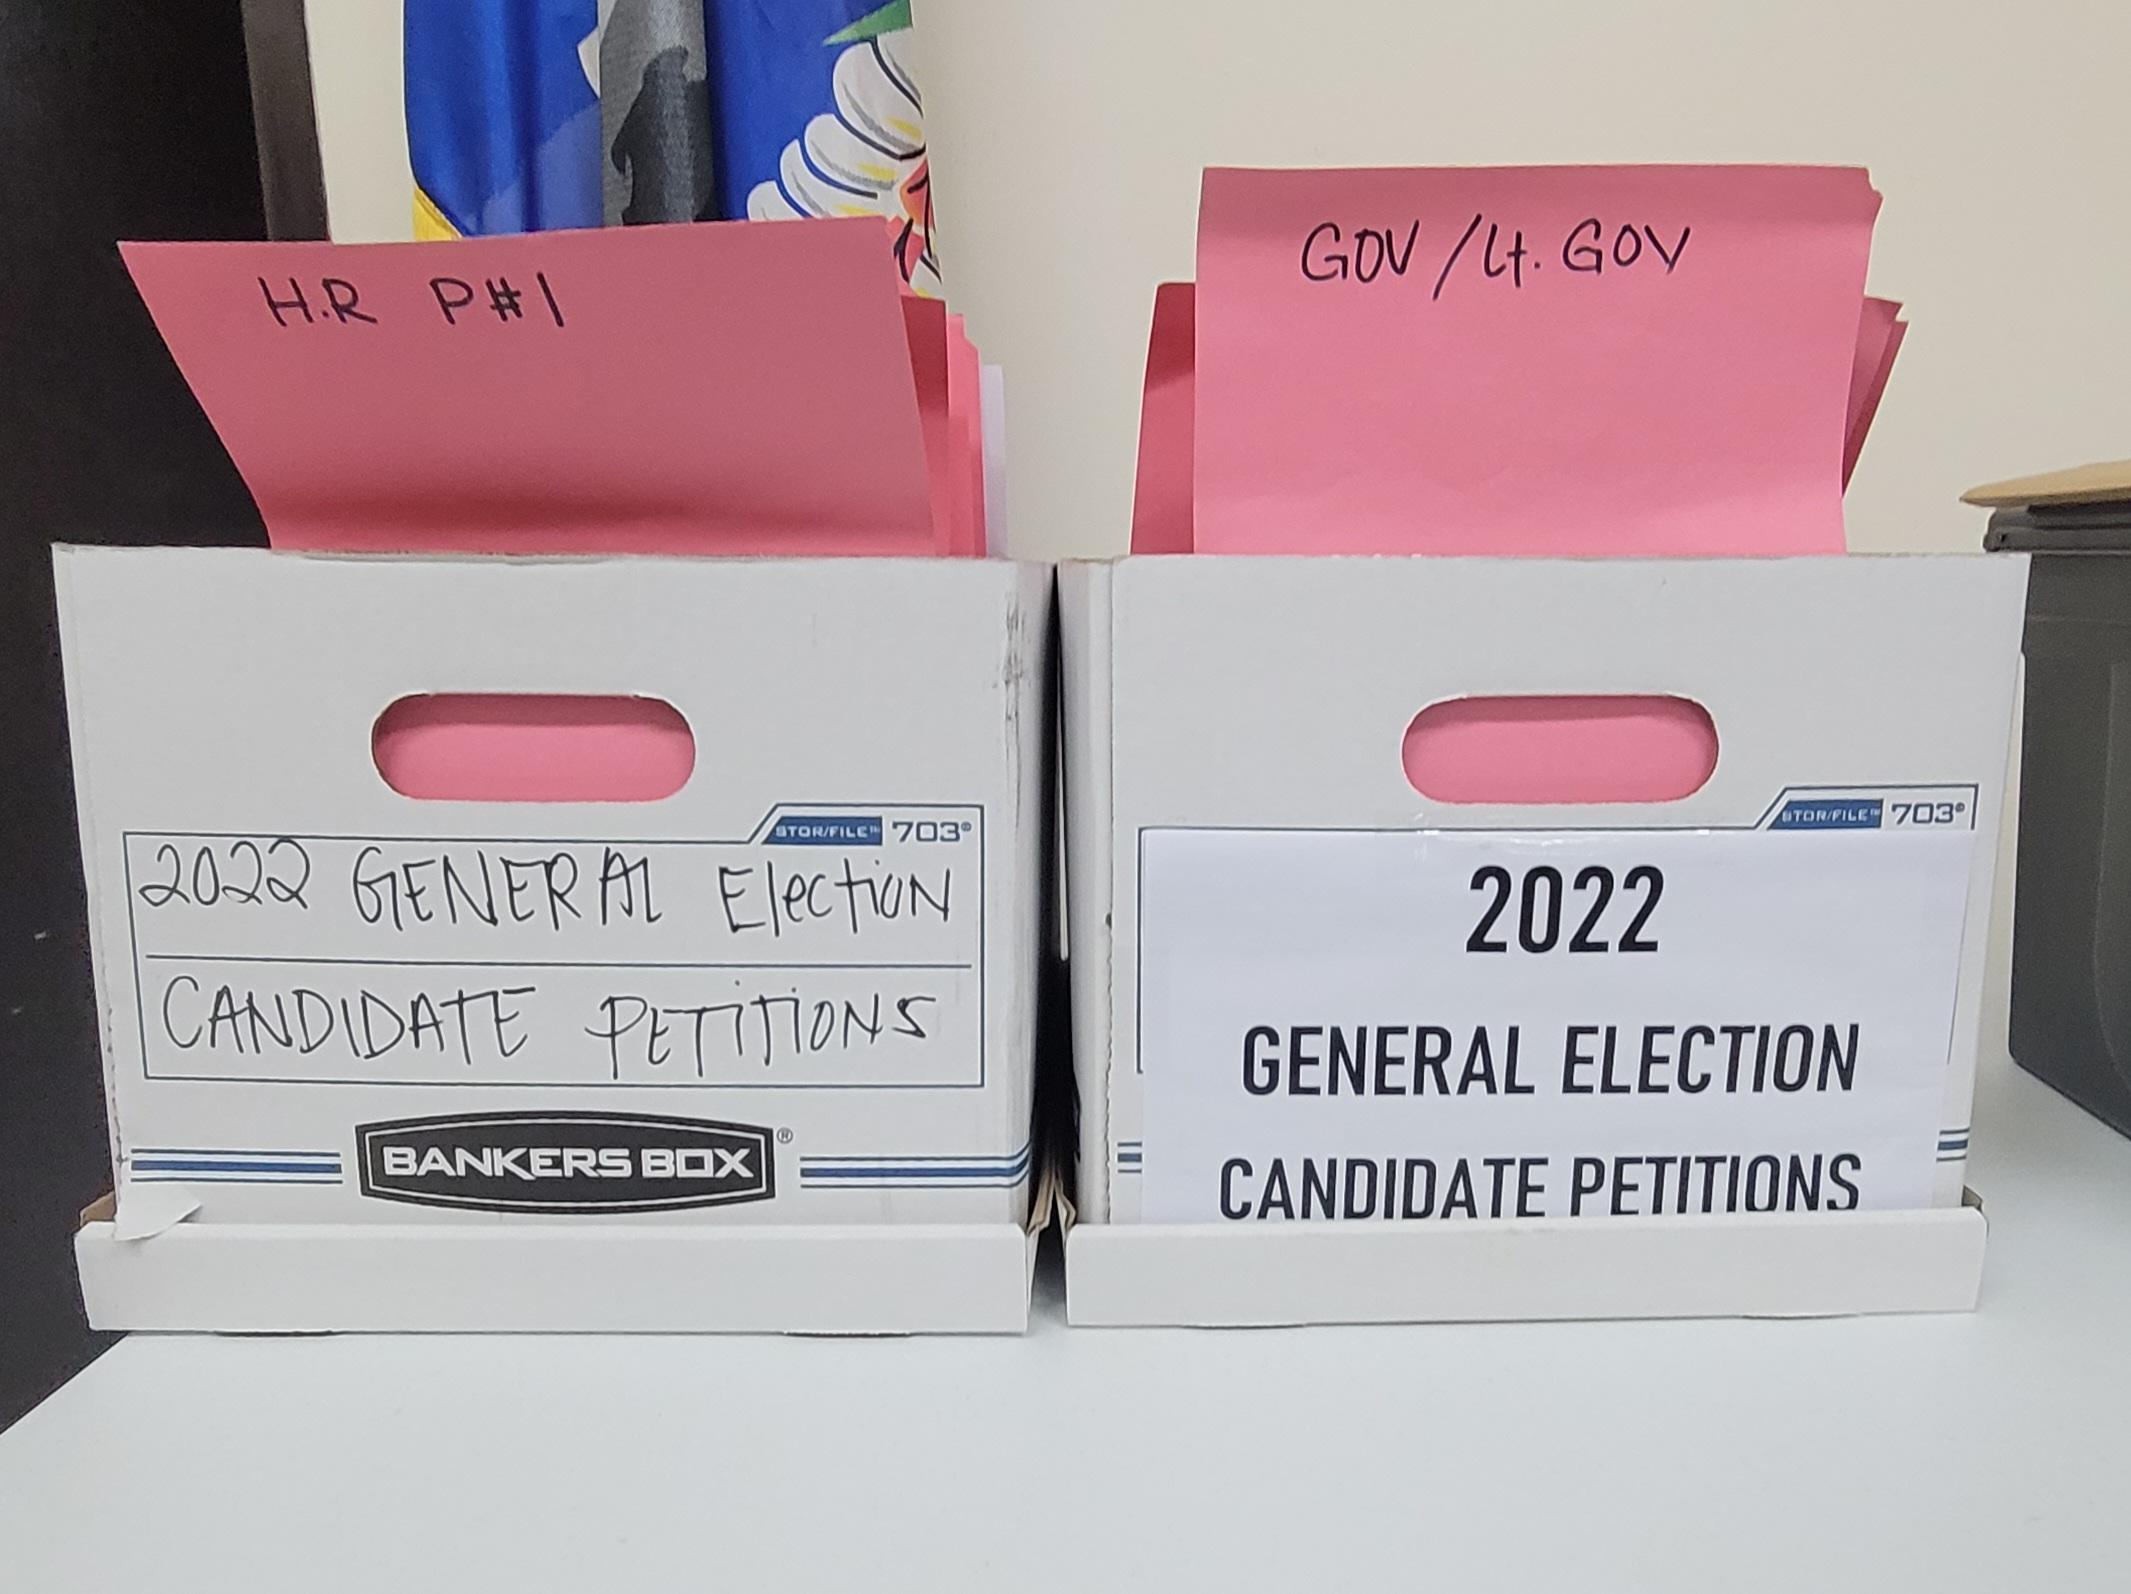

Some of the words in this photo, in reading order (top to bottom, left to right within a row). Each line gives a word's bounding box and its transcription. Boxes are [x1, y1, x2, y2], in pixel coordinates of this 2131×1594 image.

[1300, 219, 1421, 284] GOV
[1562, 217, 1692, 275] GOV
[256, 275, 379, 328] H.R
[428, 271, 567, 329] P#1
[137, 838, 312, 910] 2022
[351, 845, 664, 932] GENERAL
[1465, 864, 1665, 955] 2022
[162, 974, 537, 1066] CANDIDATE
[584, 979, 937, 1080] PETITIONS
[1242, 1024, 1536, 1097] GENERAL
[1561, 1022, 1860, 1095] ELECTION
[381, 1145, 633, 1181] BANKERS
[640, 1148, 754, 1179] BOX
[1219, 1156, 1550, 1221] CANDIDATE
[1569, 1152, 1862, 1217] PETITIONS
